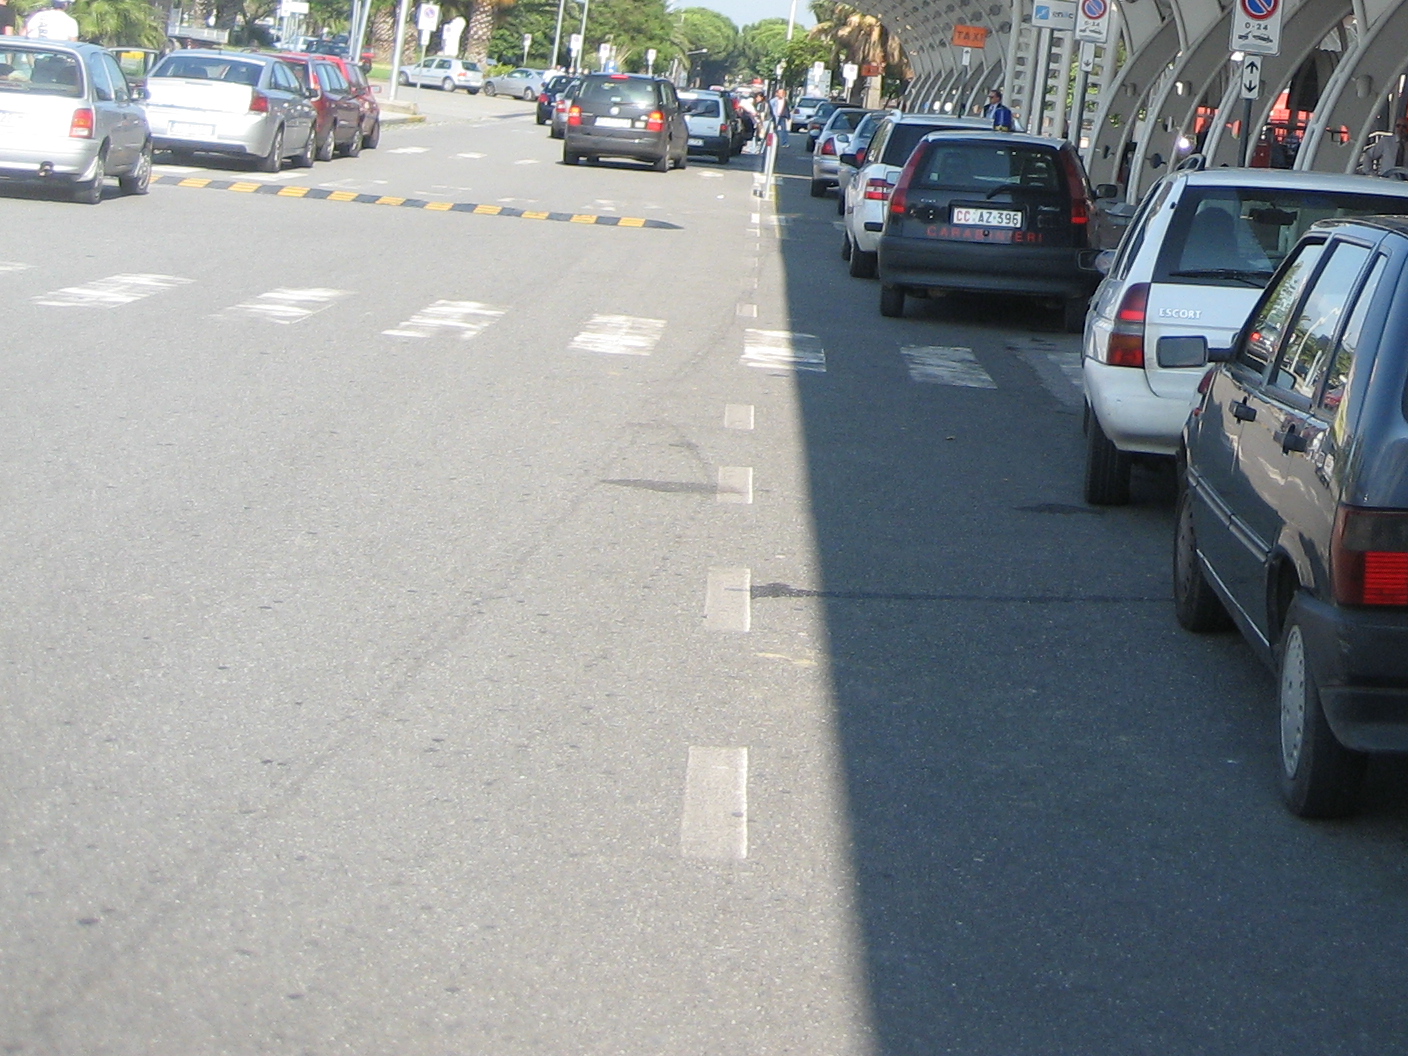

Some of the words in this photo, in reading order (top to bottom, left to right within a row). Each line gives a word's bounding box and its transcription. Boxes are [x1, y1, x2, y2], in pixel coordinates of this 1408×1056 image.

[957, 30, 985, 43] TAXI
[956, 210, 970, 222] CC
[926, 225, 1044, 243] CARABINIERI
[1158, 307, 1202, 319] ESCORT
